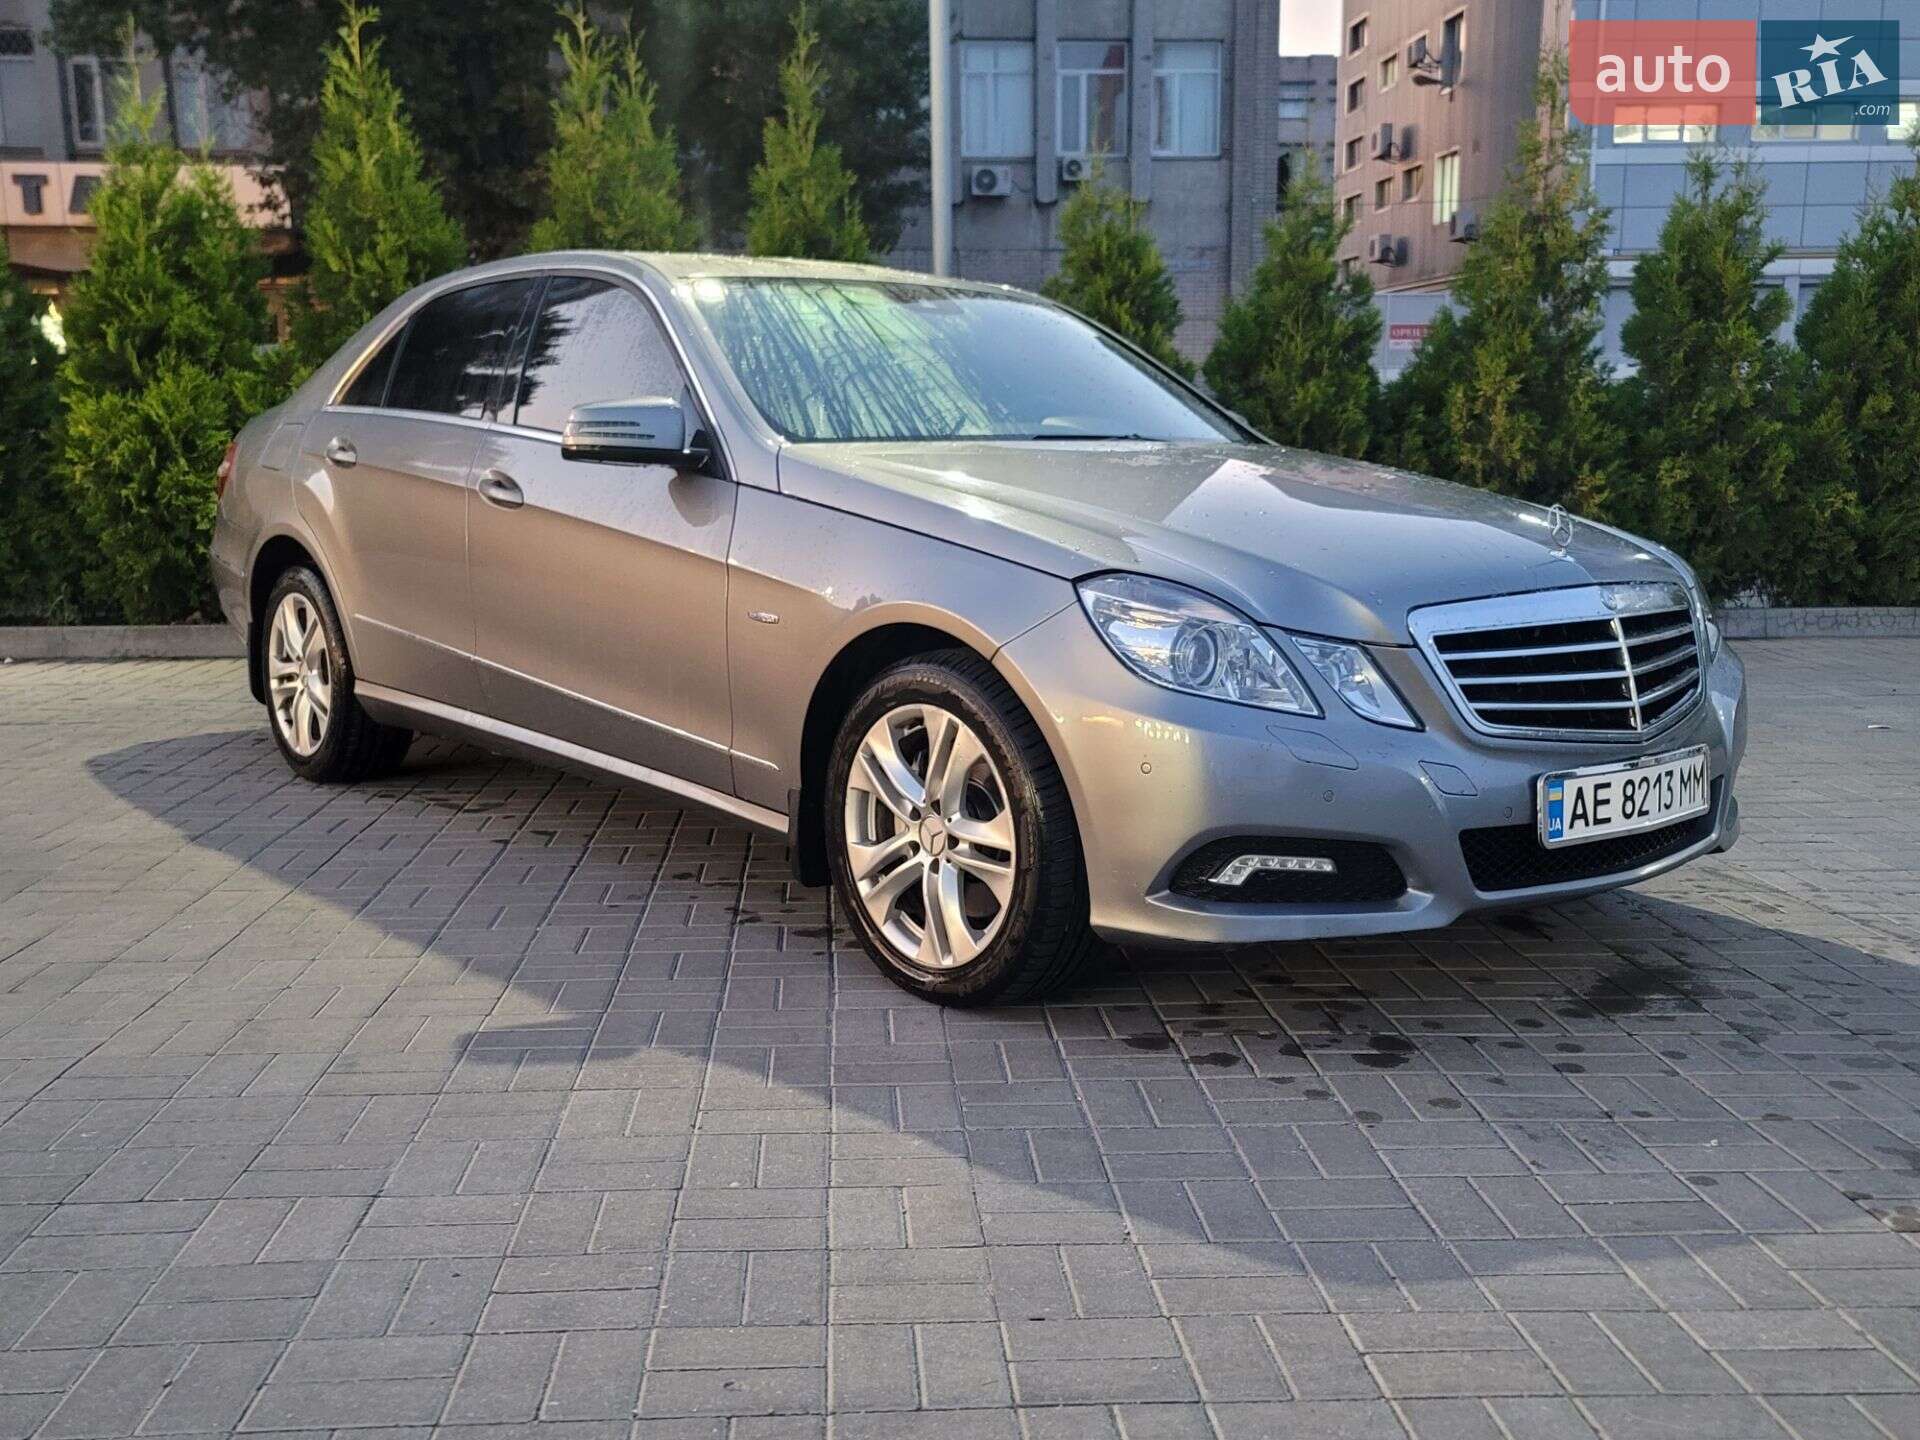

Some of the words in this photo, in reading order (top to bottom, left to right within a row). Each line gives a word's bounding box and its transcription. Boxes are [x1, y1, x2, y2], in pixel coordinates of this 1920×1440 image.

[1569, 782, 1612, 829] AE
[1621, 770, 1674, 820] 8213
[1679, 761, 1706, 807] MM
[1548, 817, 1562, 832] UA
